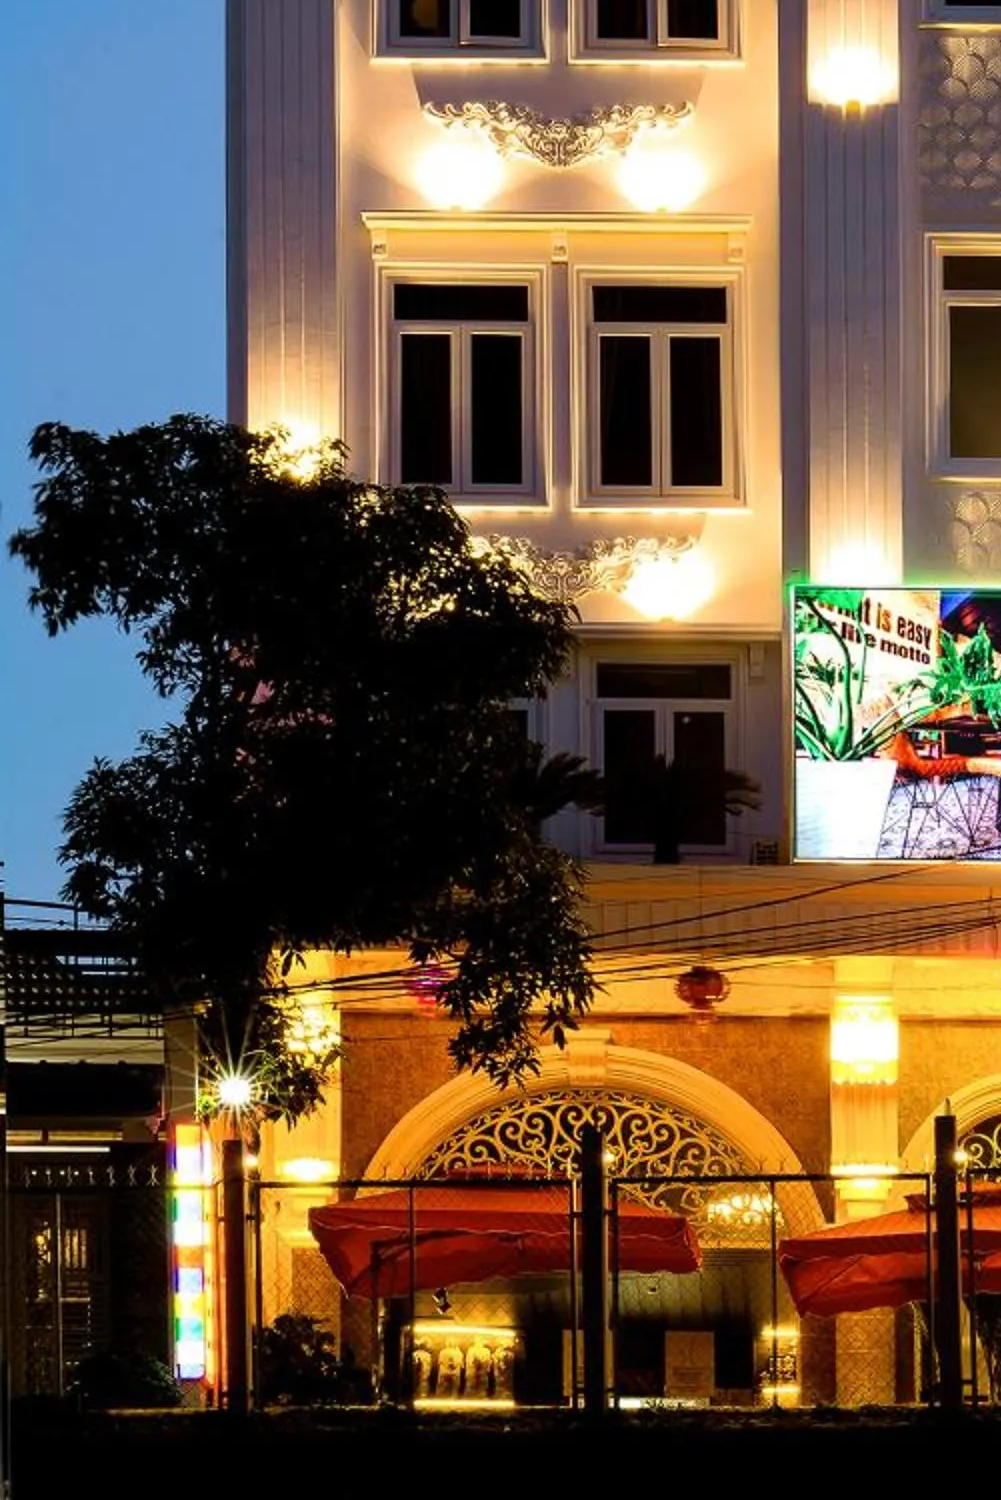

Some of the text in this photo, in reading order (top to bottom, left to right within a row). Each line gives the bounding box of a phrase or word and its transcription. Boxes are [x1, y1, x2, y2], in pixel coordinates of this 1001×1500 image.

[876, 602, 891, 632] is
[897, 615, 932, 650] easy
[879, 638, 931, 665] motto
